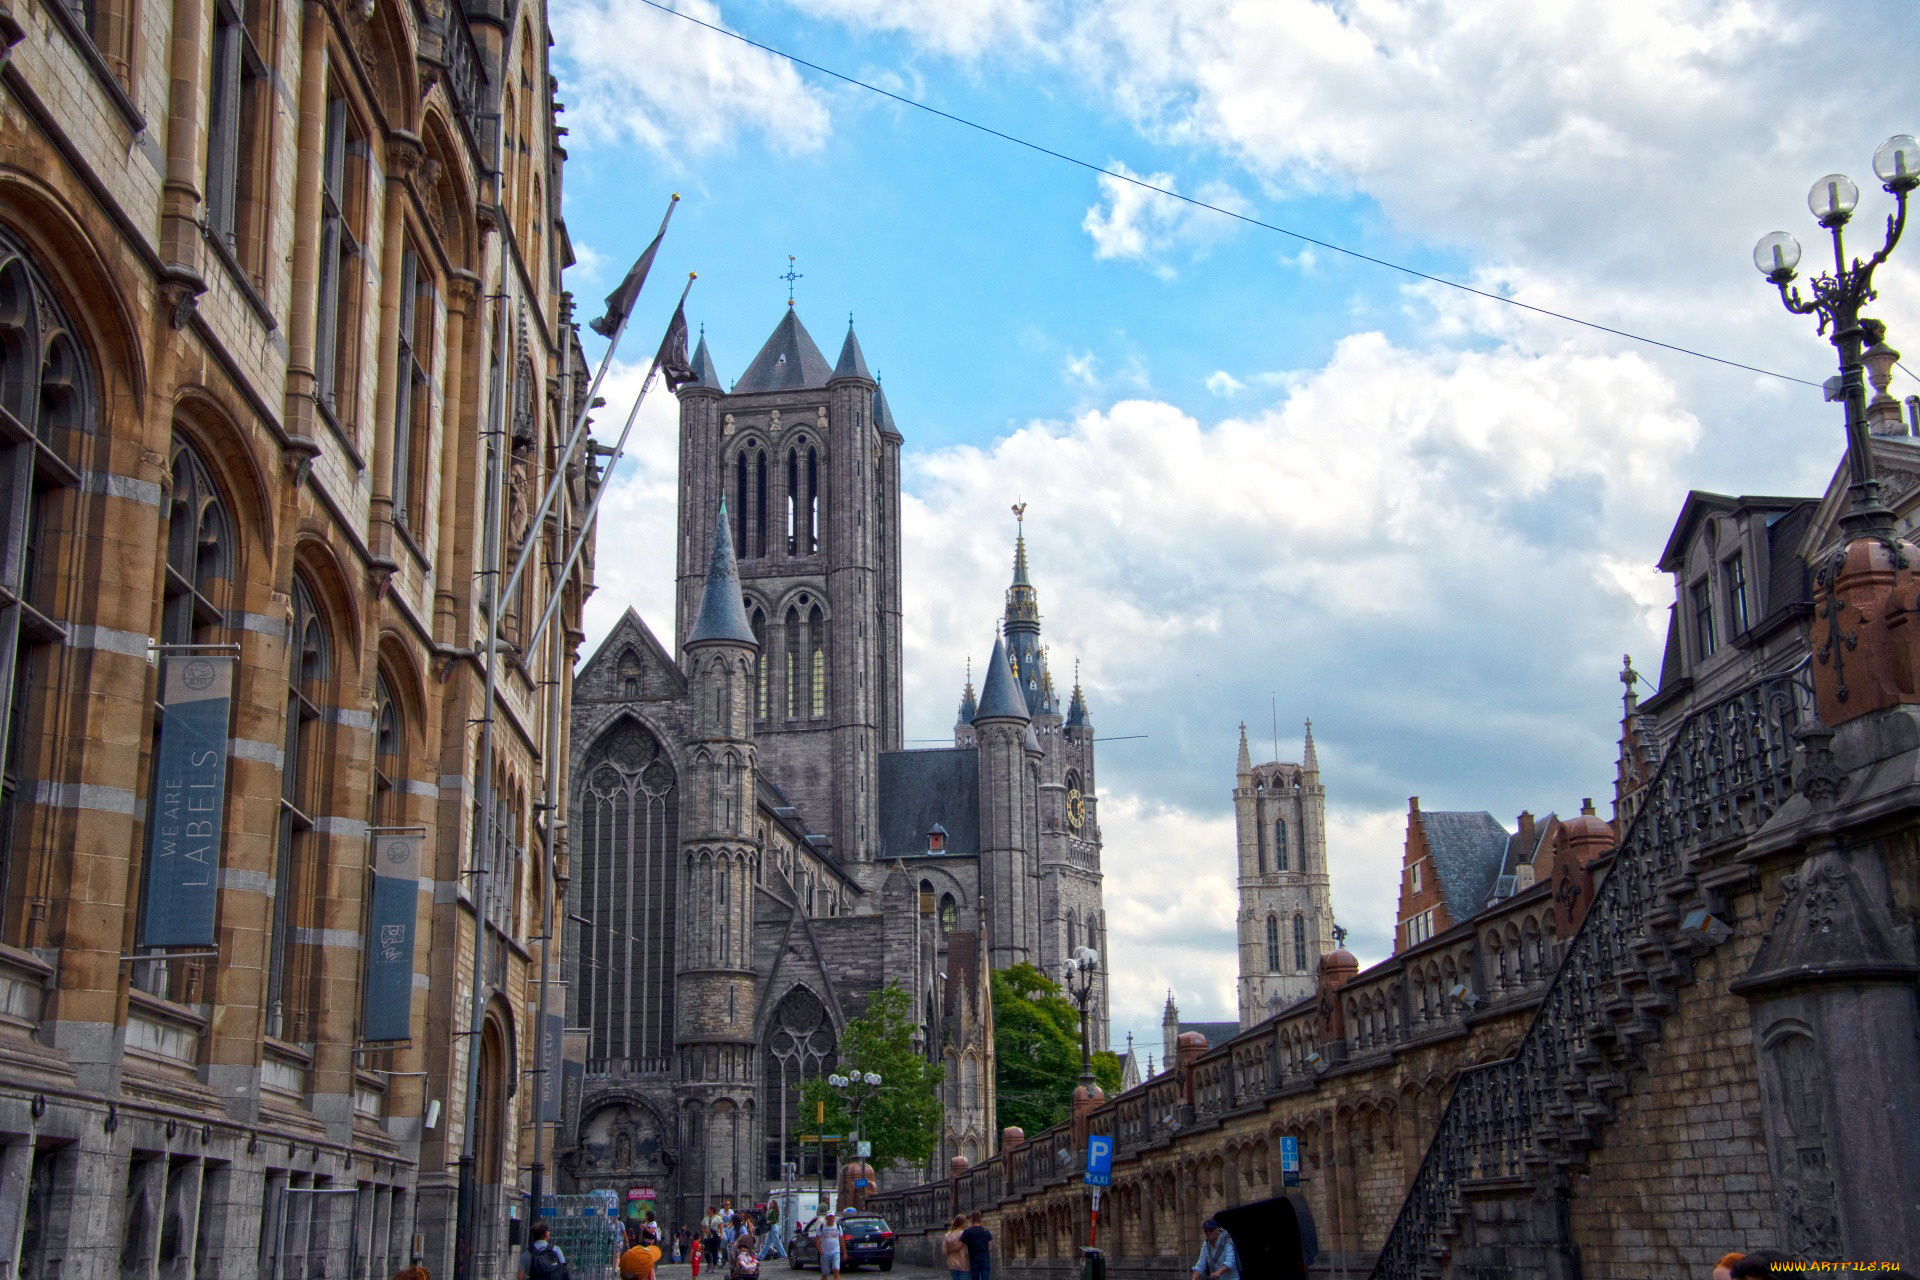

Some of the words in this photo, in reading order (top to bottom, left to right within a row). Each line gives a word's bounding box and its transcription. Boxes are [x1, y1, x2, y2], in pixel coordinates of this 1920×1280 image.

[164, 778, 183, 820] ARE
[182, 750, 218, 886] LABELS
[160, 826, 179, 857] WE
[1090, 1141, 1109, 1167] P
[1087, 1174, 1108, 1184] TAXI
